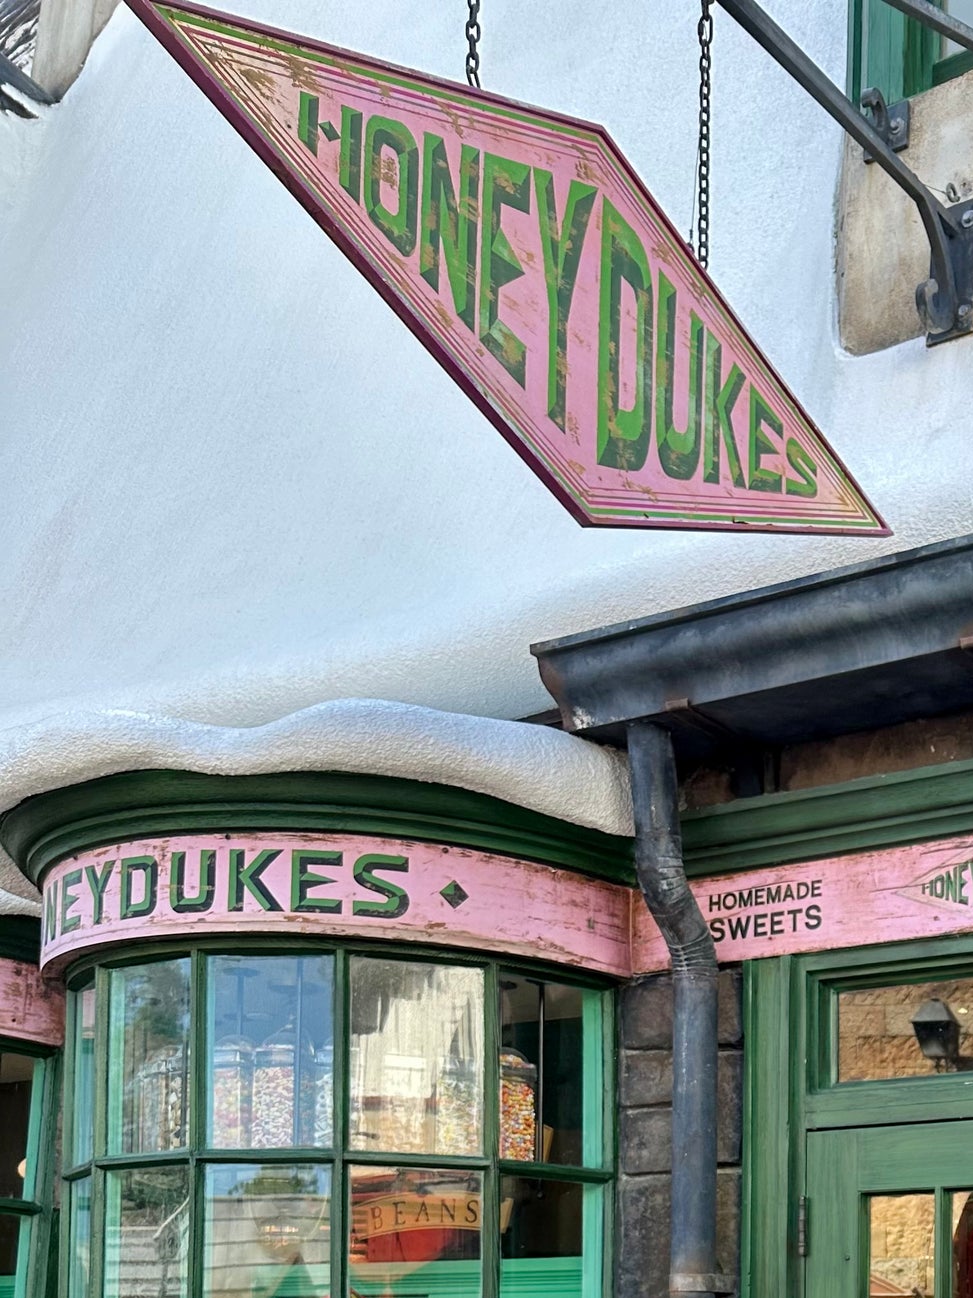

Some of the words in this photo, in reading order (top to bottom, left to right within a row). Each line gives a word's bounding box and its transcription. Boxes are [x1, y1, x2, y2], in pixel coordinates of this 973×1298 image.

[300, 92, 818, 499] HONEYDUKES
[709, 880, 822, 912] HOMEMADE
[709, 904, 822, 942] SWEETS
[370, 1199, 479, 1230] BEANS
